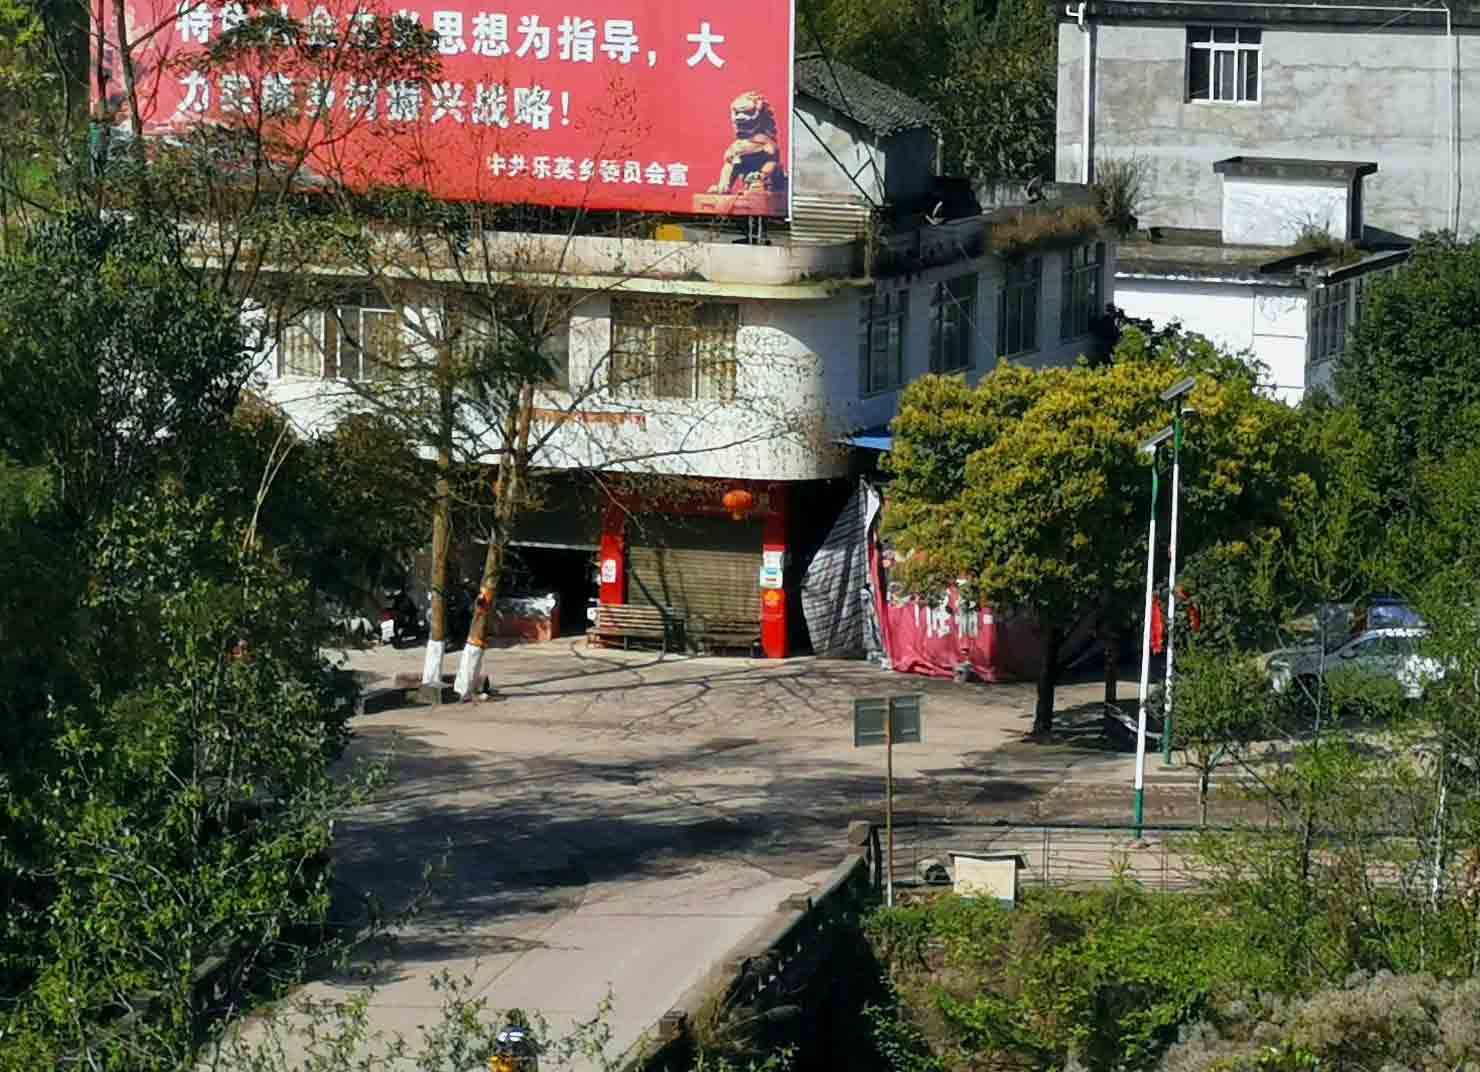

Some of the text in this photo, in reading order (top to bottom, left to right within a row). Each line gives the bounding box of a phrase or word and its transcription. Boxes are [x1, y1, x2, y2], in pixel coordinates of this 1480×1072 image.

[486, 152, 689, 186] 中共乐英乡委员会宣
